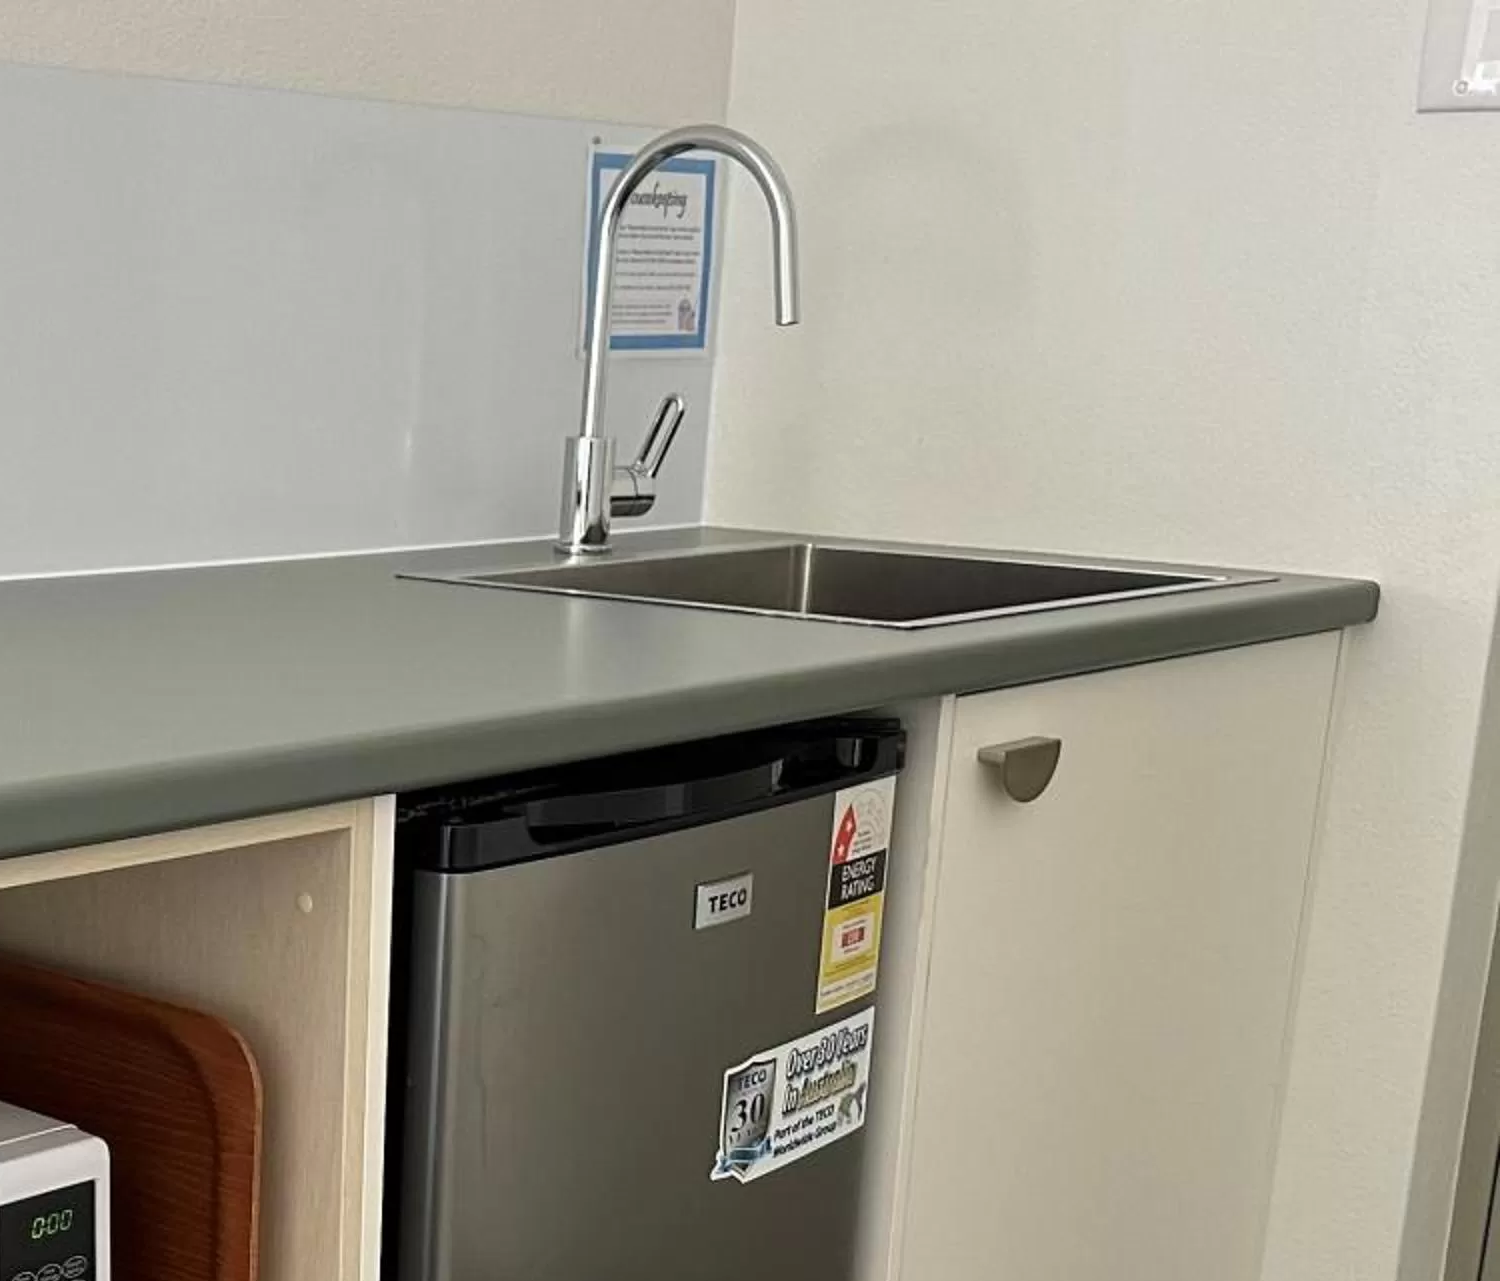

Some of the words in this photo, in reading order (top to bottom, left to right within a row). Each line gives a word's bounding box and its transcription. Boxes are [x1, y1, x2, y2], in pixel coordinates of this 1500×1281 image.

[841, 857, 876, 882] ENERGY
[708, 887, 748, 913] TECO
[840, 875, 875, 900] RATING
[785, 1046, 819, 1081] Over
[739, 1069, 767, 1091] TECO
[731, 1092, 765, 1133] 30
[815, 1103, 835, 1122] TECO
